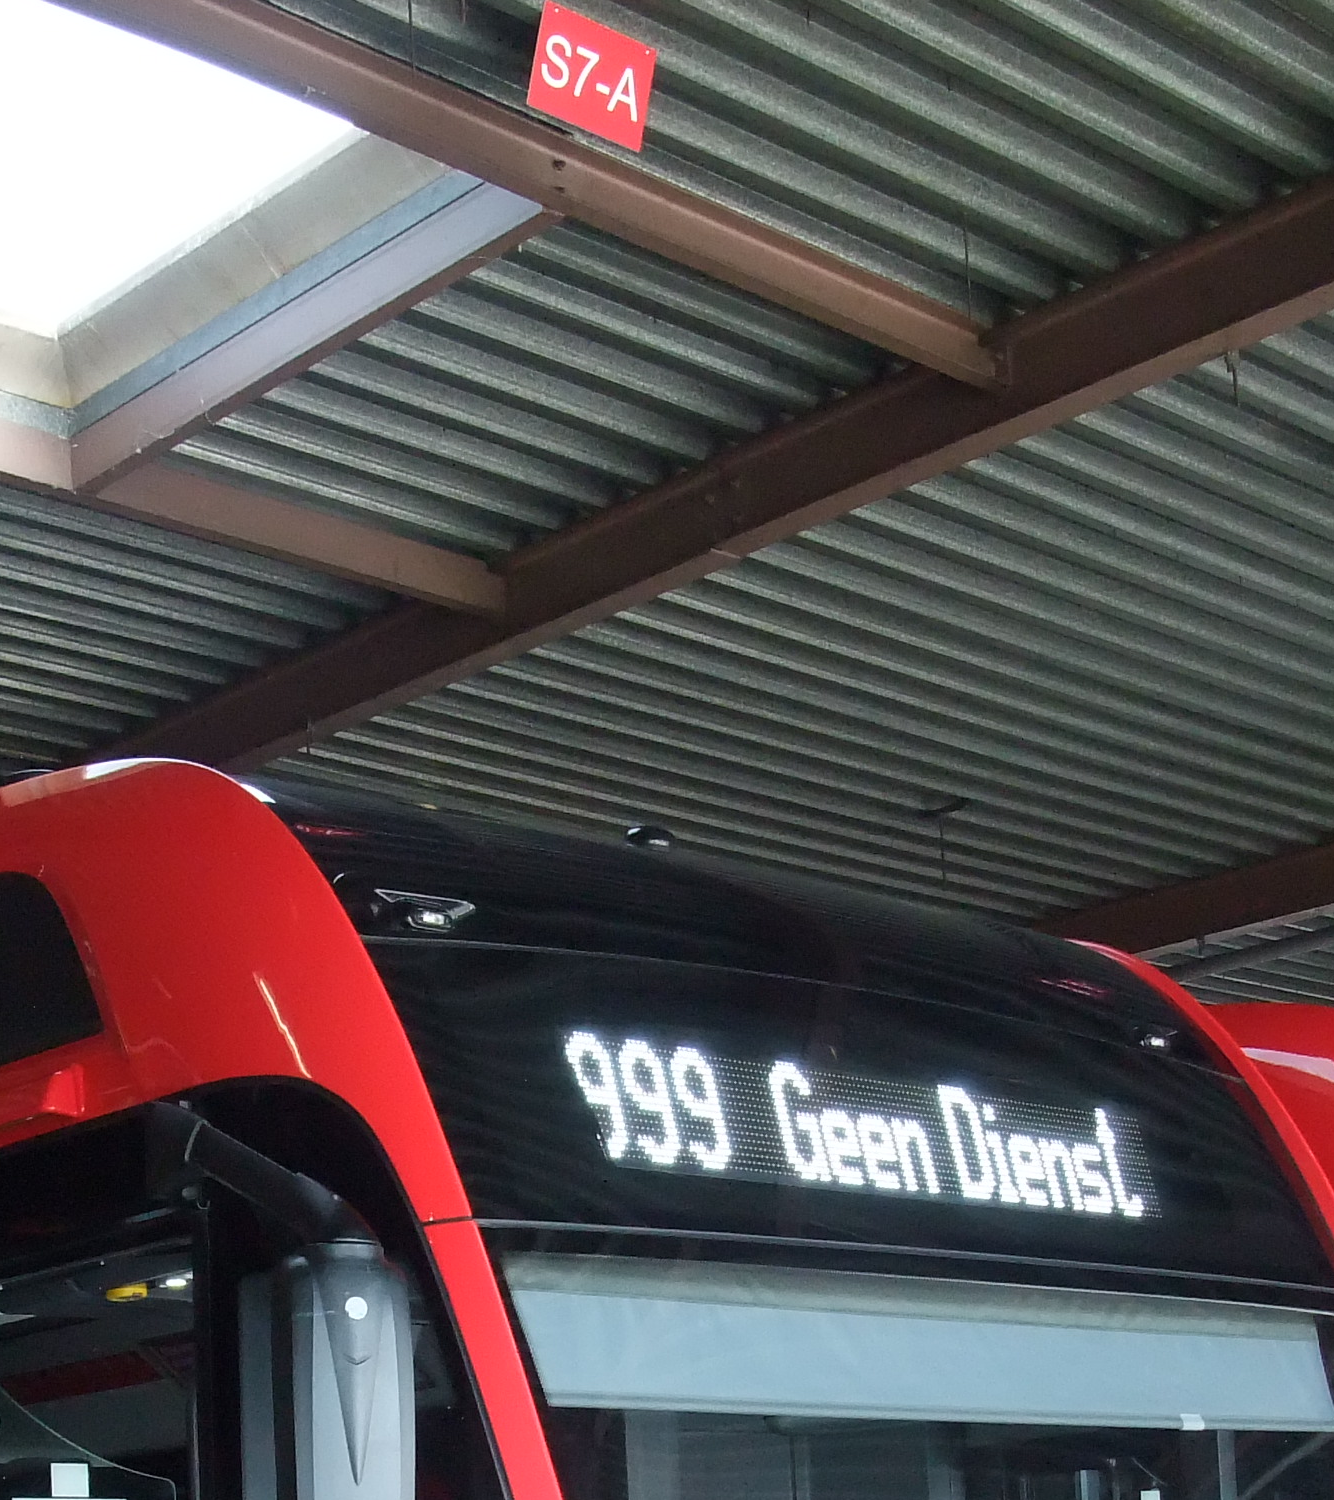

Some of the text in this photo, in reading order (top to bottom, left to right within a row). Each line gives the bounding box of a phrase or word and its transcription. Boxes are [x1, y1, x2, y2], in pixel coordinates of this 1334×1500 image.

[540, 34, 638, 123] S7-A
[565, 1030, 1145, 1218] 999 Geen Dienst
